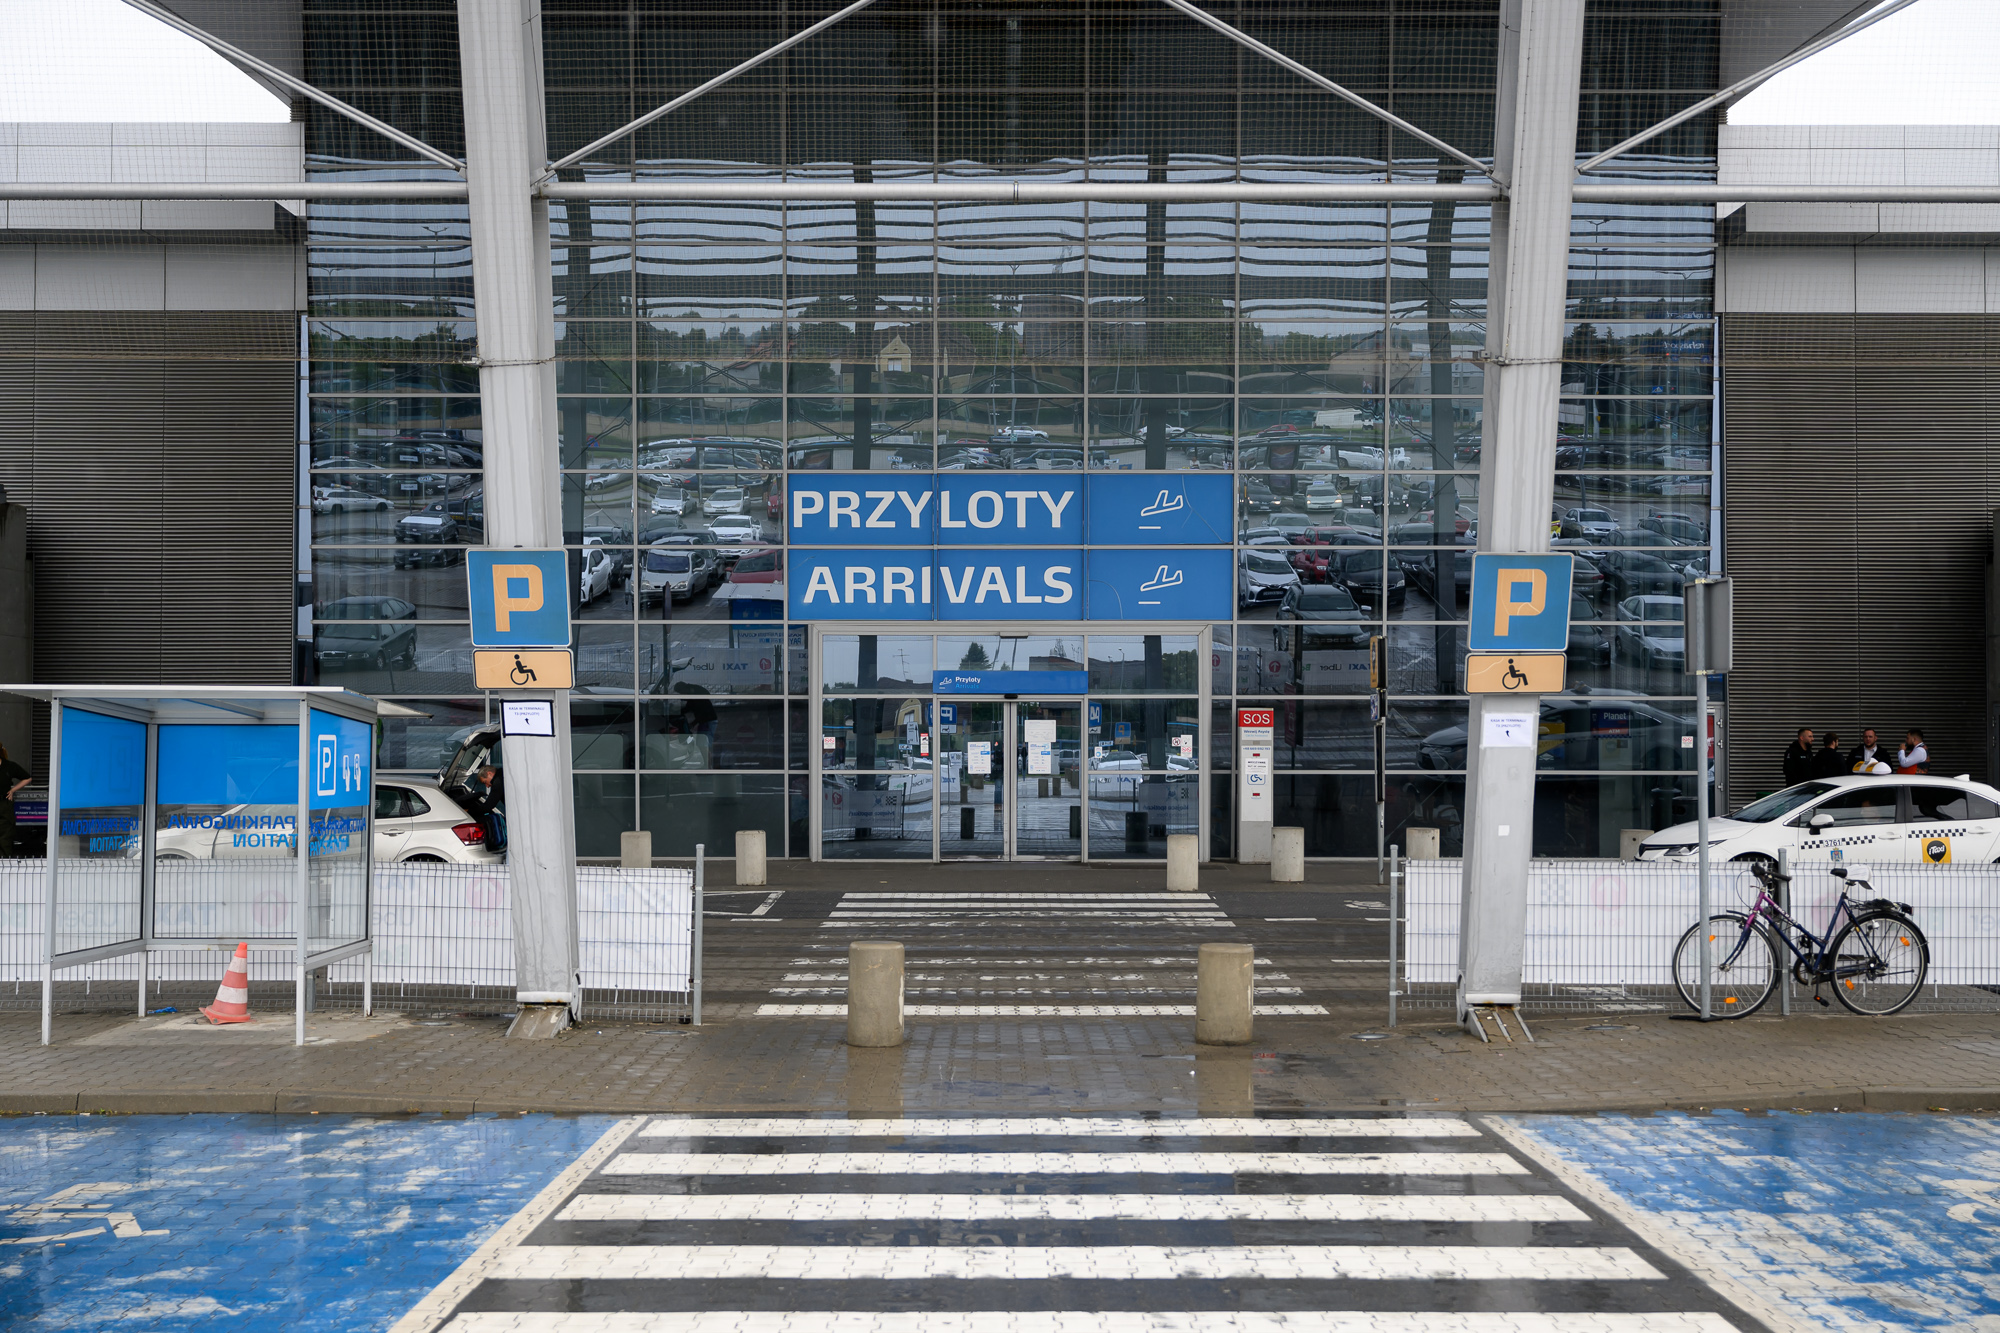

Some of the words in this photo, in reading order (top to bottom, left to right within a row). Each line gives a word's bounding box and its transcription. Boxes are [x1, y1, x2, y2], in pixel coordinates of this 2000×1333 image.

[793, 490, 1074, 529] PRZYLOTY
[491, 564, 544, 632] P
[803, 565, 1073, 604] ARRIVALS
[1494, 568, 1548, 637] P
[1243, 713, 1270, 724] SOS
[322, 746, 332, 784] P
[1928, 844, 1945, 856] iTaxi
